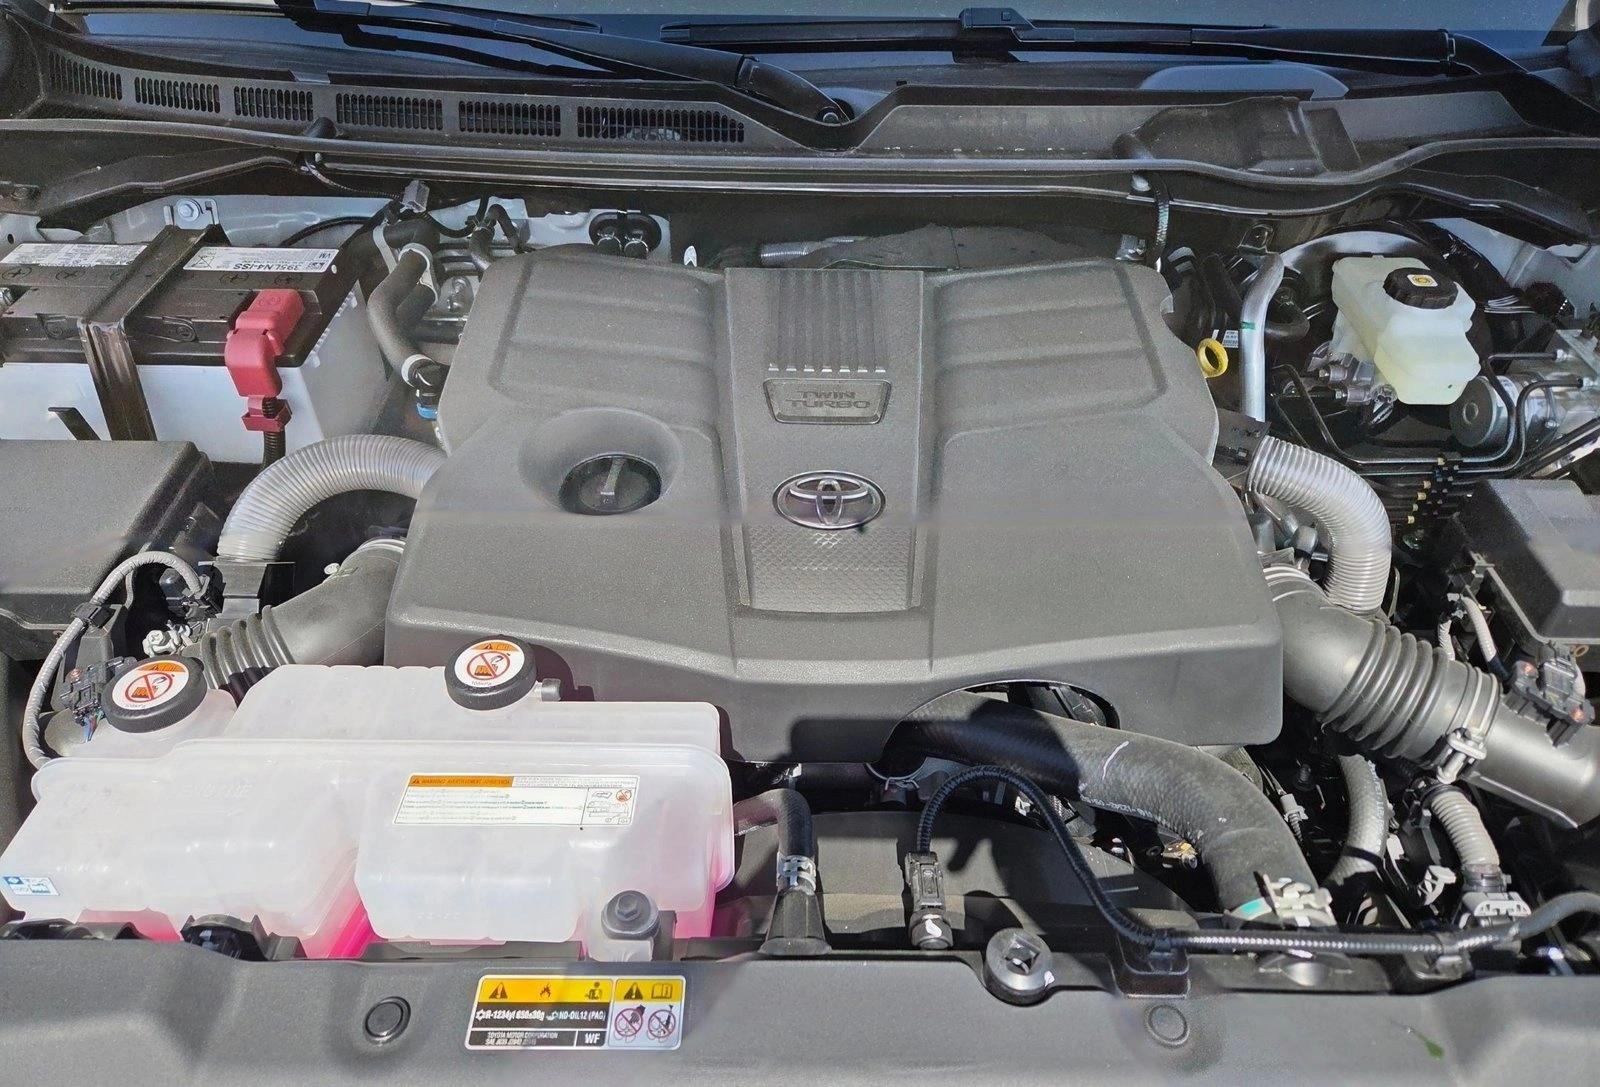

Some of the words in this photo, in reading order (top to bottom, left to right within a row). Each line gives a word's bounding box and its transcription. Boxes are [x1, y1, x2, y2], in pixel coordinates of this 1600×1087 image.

[233, 263, 302, 271] 395LN4-ISS
[797, 390, 856, 399] TWIN
[784, 399, 871, 409] TURBO
[584, 1033, 601, 1044] WF
